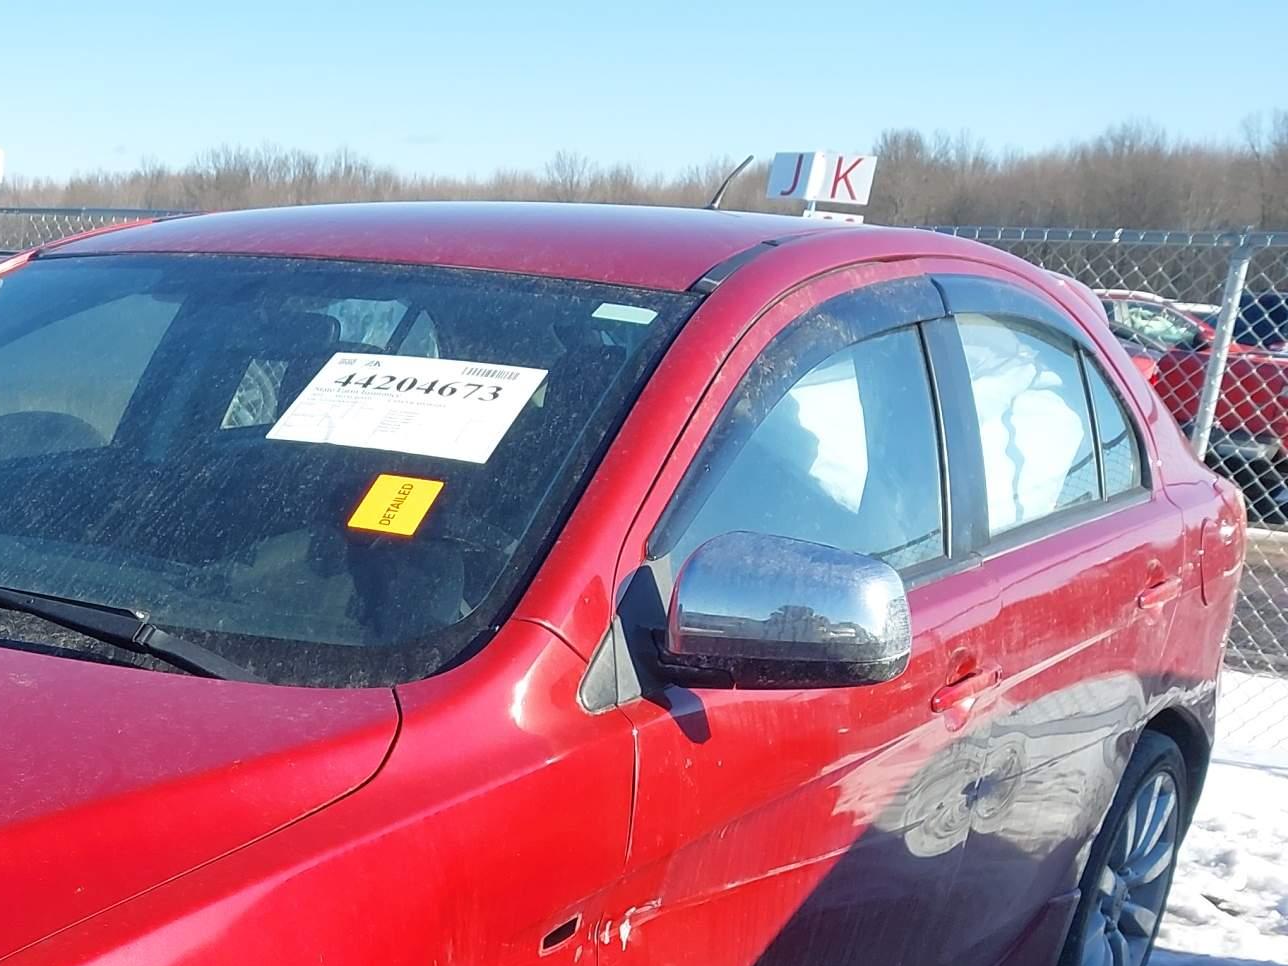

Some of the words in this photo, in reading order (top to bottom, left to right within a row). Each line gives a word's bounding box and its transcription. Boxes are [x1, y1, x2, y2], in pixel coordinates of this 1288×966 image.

[779, 153, 804, 196] J
[830, 156, 864, 200] K
[333, 372, 504, 402] 44204673
[378, 482, 414, 526] DETAILED
